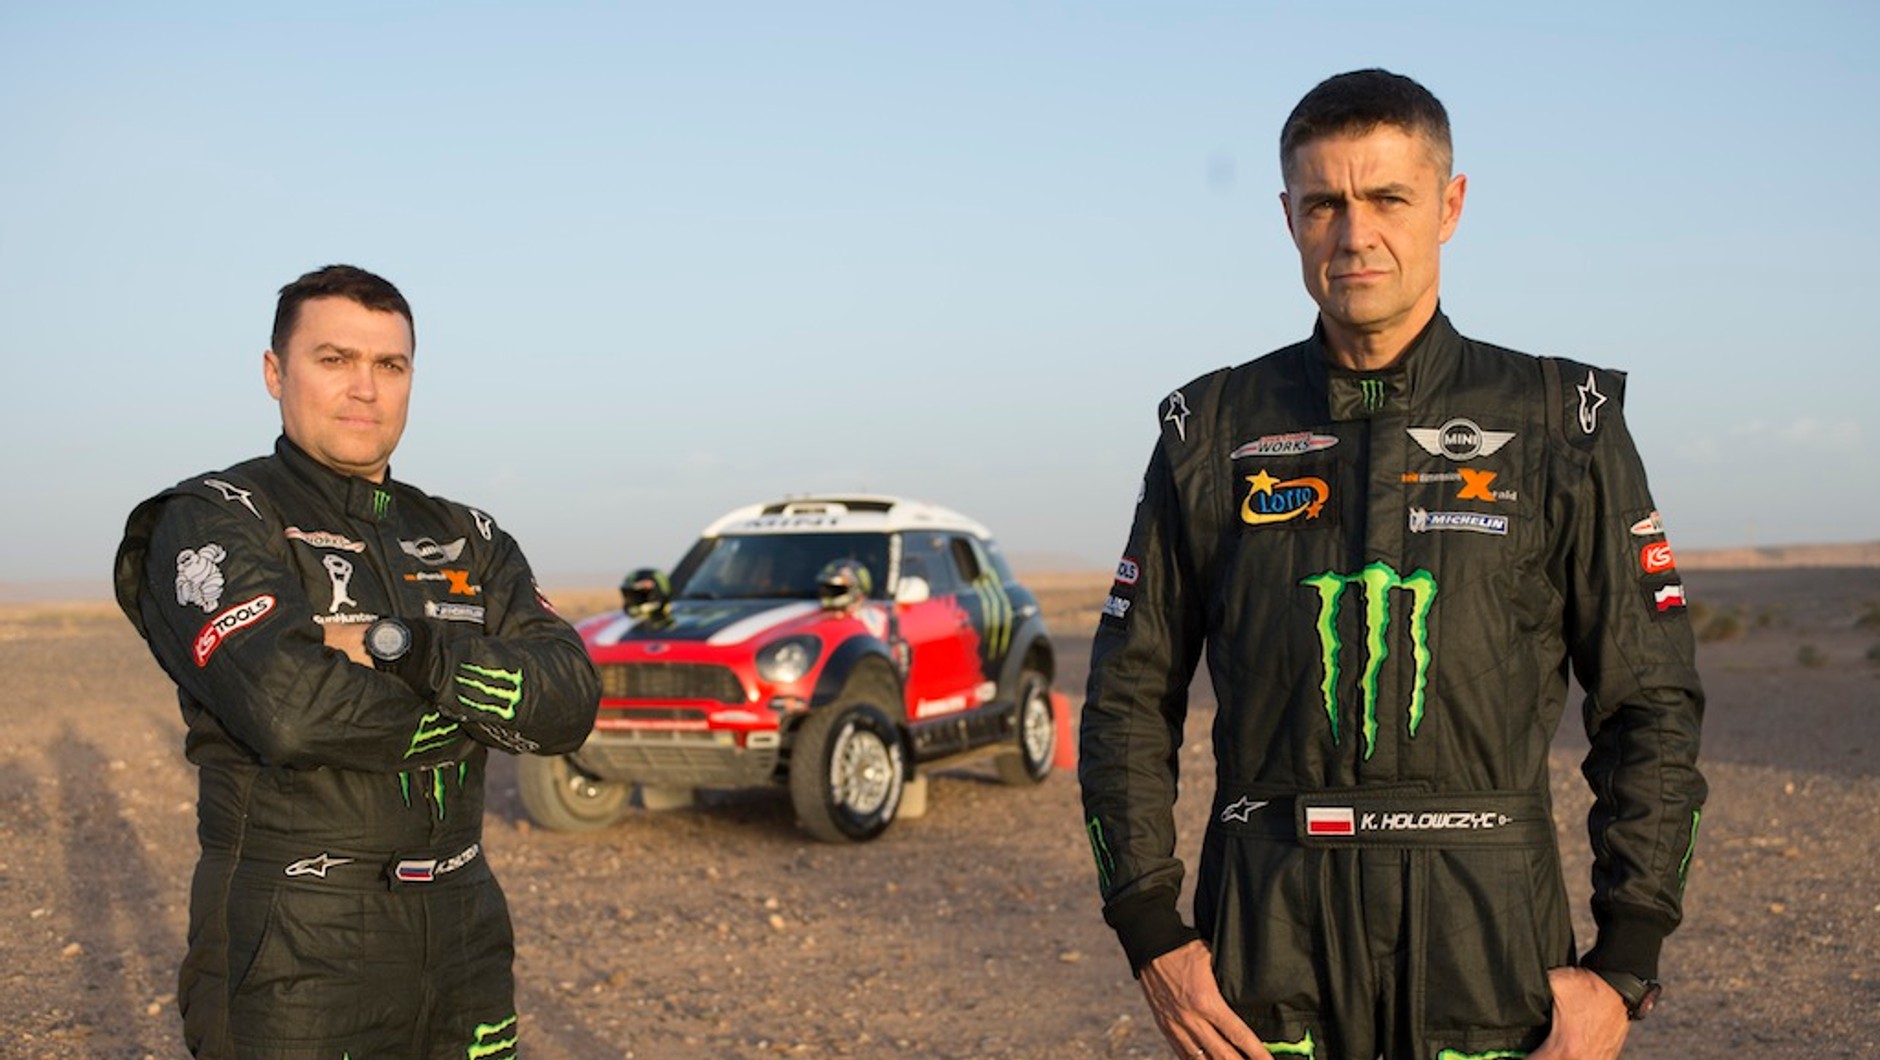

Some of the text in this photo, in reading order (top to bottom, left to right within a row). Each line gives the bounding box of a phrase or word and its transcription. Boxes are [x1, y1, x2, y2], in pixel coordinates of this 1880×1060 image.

[1259, 439, 1310, 453] WORKS
[1444, 432, 1478, 446] MINI
[1430, 514, 1505, 530] MICHELIN
[1646, 546, 1672, 569] KS
[213, 598, 269, 633] TOOLS
[1361, 812, 1378, 829] K.
[1380, 812, 1496, 829] HOLOWCZYC
